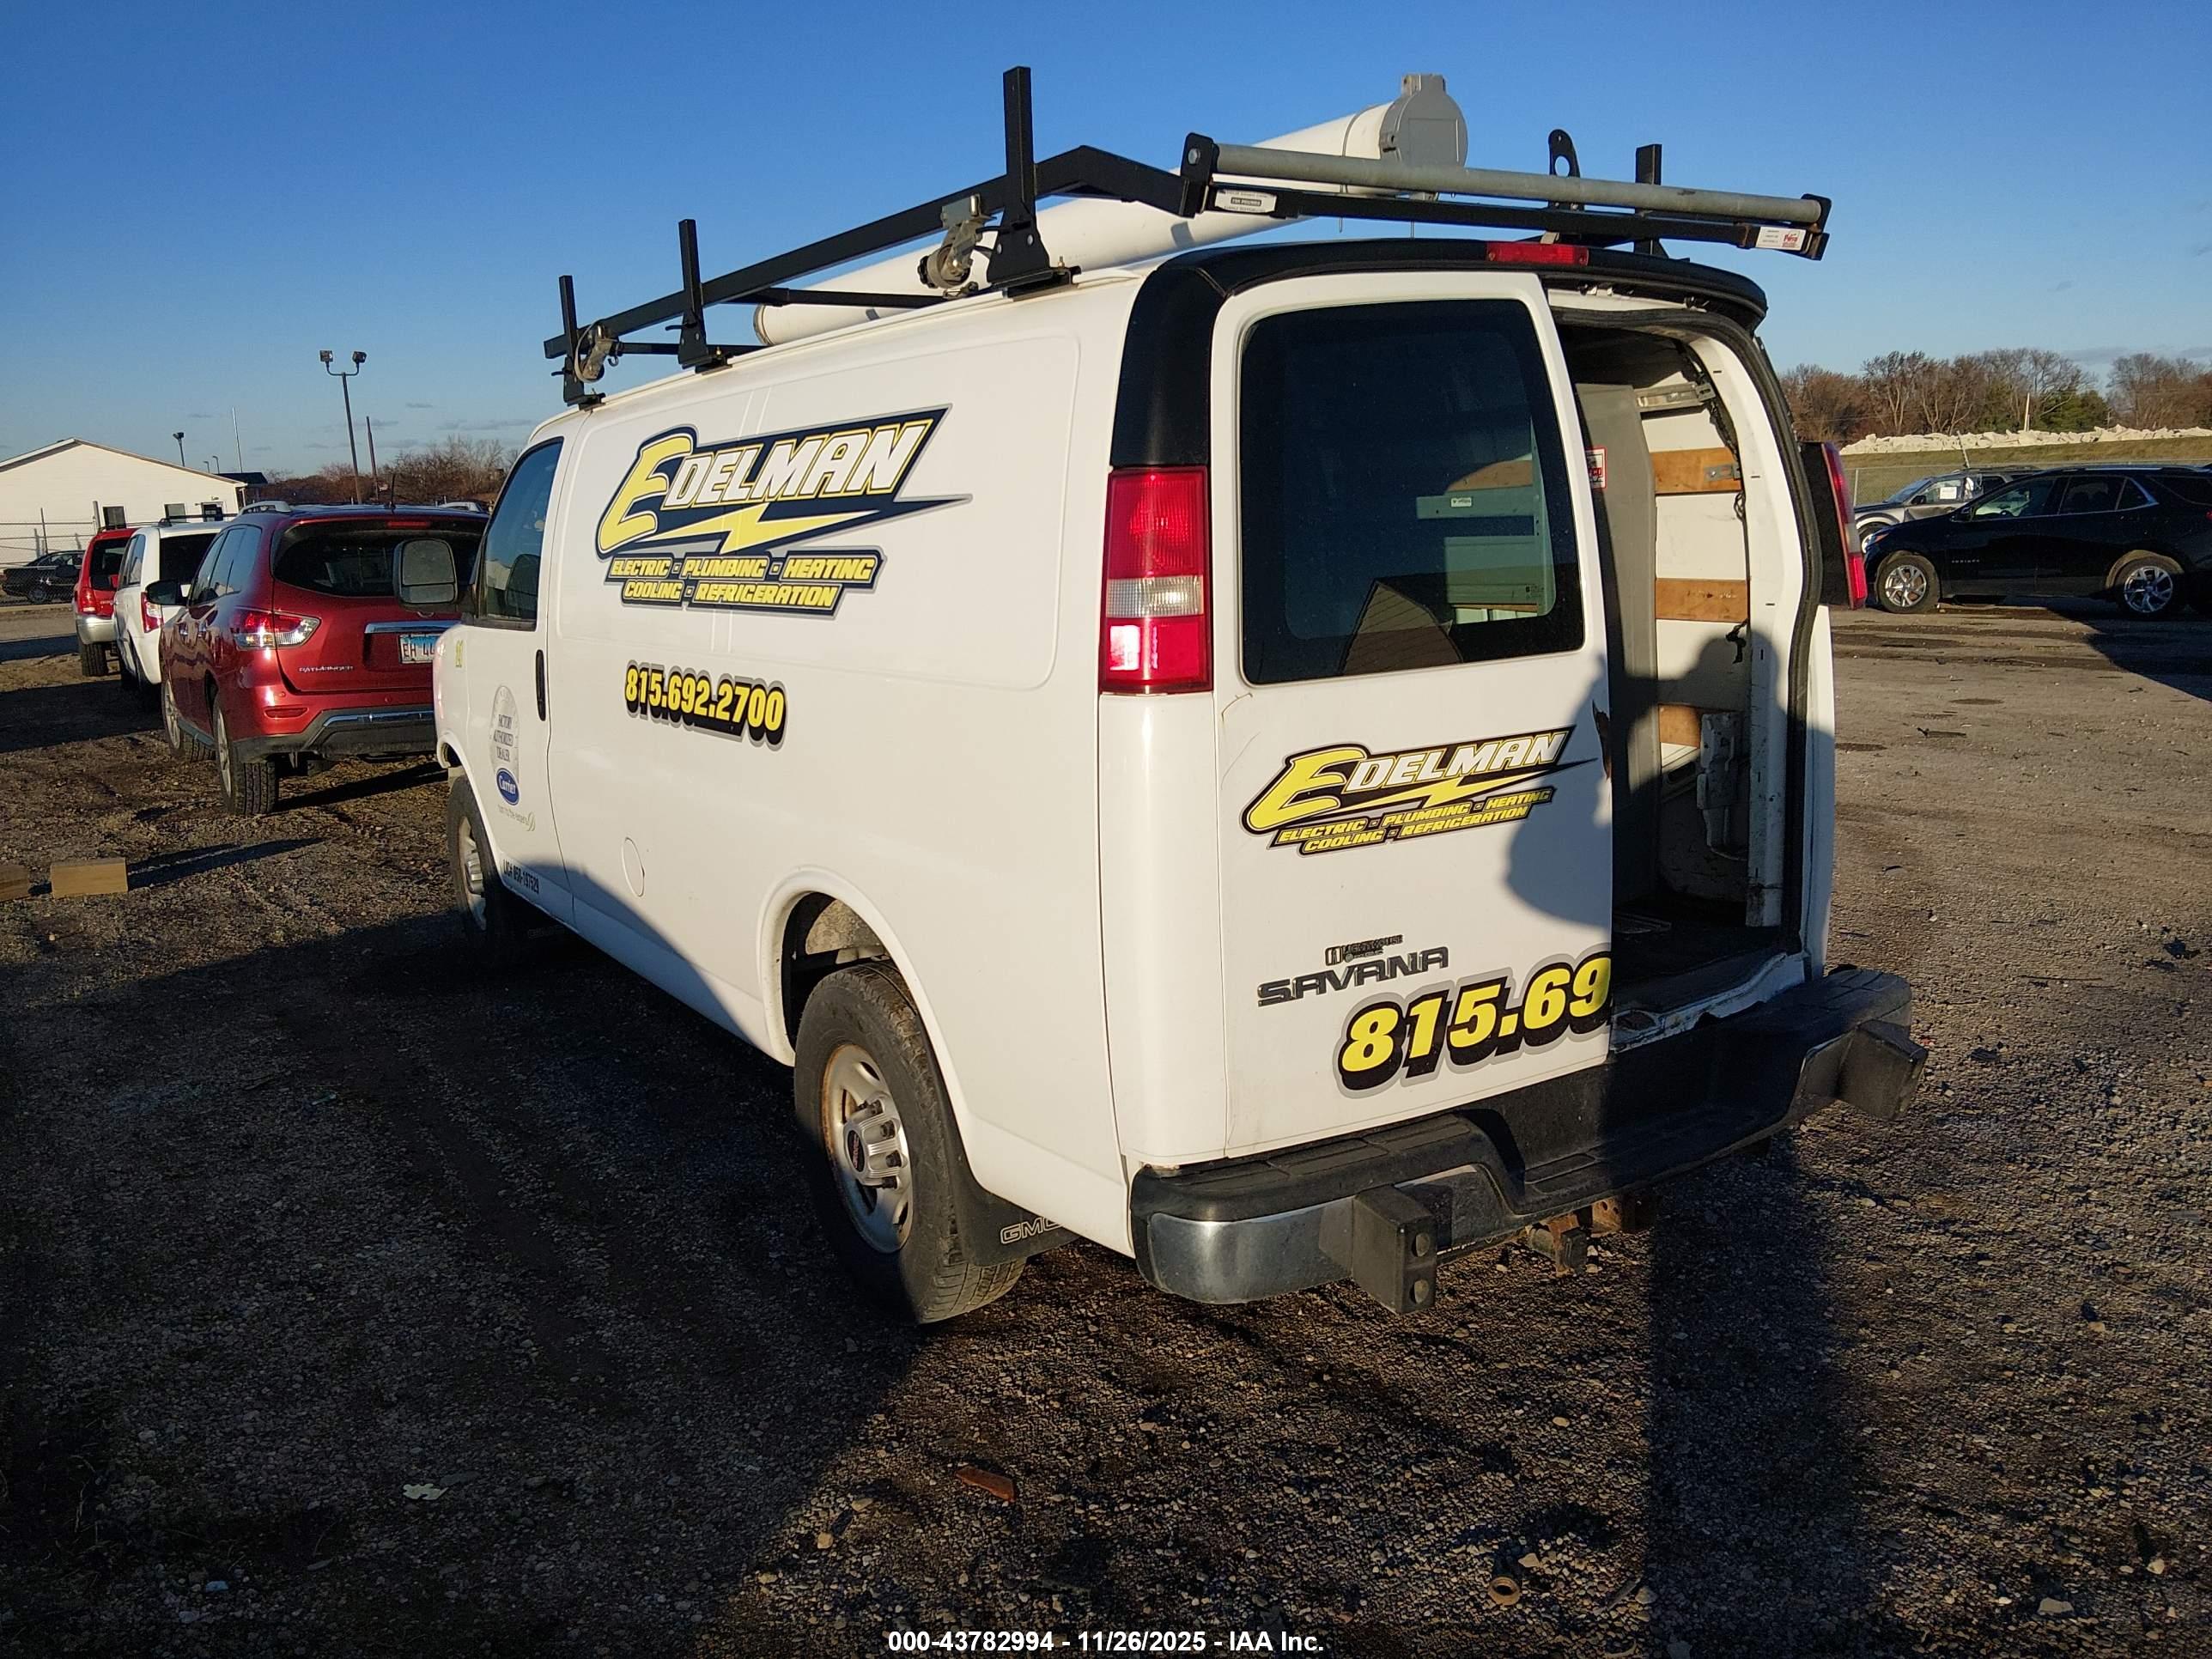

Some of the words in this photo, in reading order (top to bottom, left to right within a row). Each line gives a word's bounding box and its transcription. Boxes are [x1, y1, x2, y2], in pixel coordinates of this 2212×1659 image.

[597, 418, 934, 555] EDELMAN
[611, 558, 671, 576] ELECTRIC
[681, 558, 768, 579] PLUMBING
[783, 558, 876, 581] HEATING
[623, 580, 684, 599] COOLING
[695, 583, 838, 606] REFRIGERATION
[403, 643, 416, 658] EH
[624, 666, 785, 732] 815.692.2700
[498, 775, 516, 795] Carrier
[1249, 732, 1568, 830] EDELMAN
[1277, 819, 1367, 842] ELECTRIC
[1382, 803, 1472, 827] PLUMBING
[1486, 790, 1552, 811] HEATING
[1304, 830, 1385, 853] COOLING
[1400, 806, 1529, 837] REFRIGERATION
[1257, 946, 1449, 1007] SAVANA
[1340, 956, 1612, 1073] 815.69
